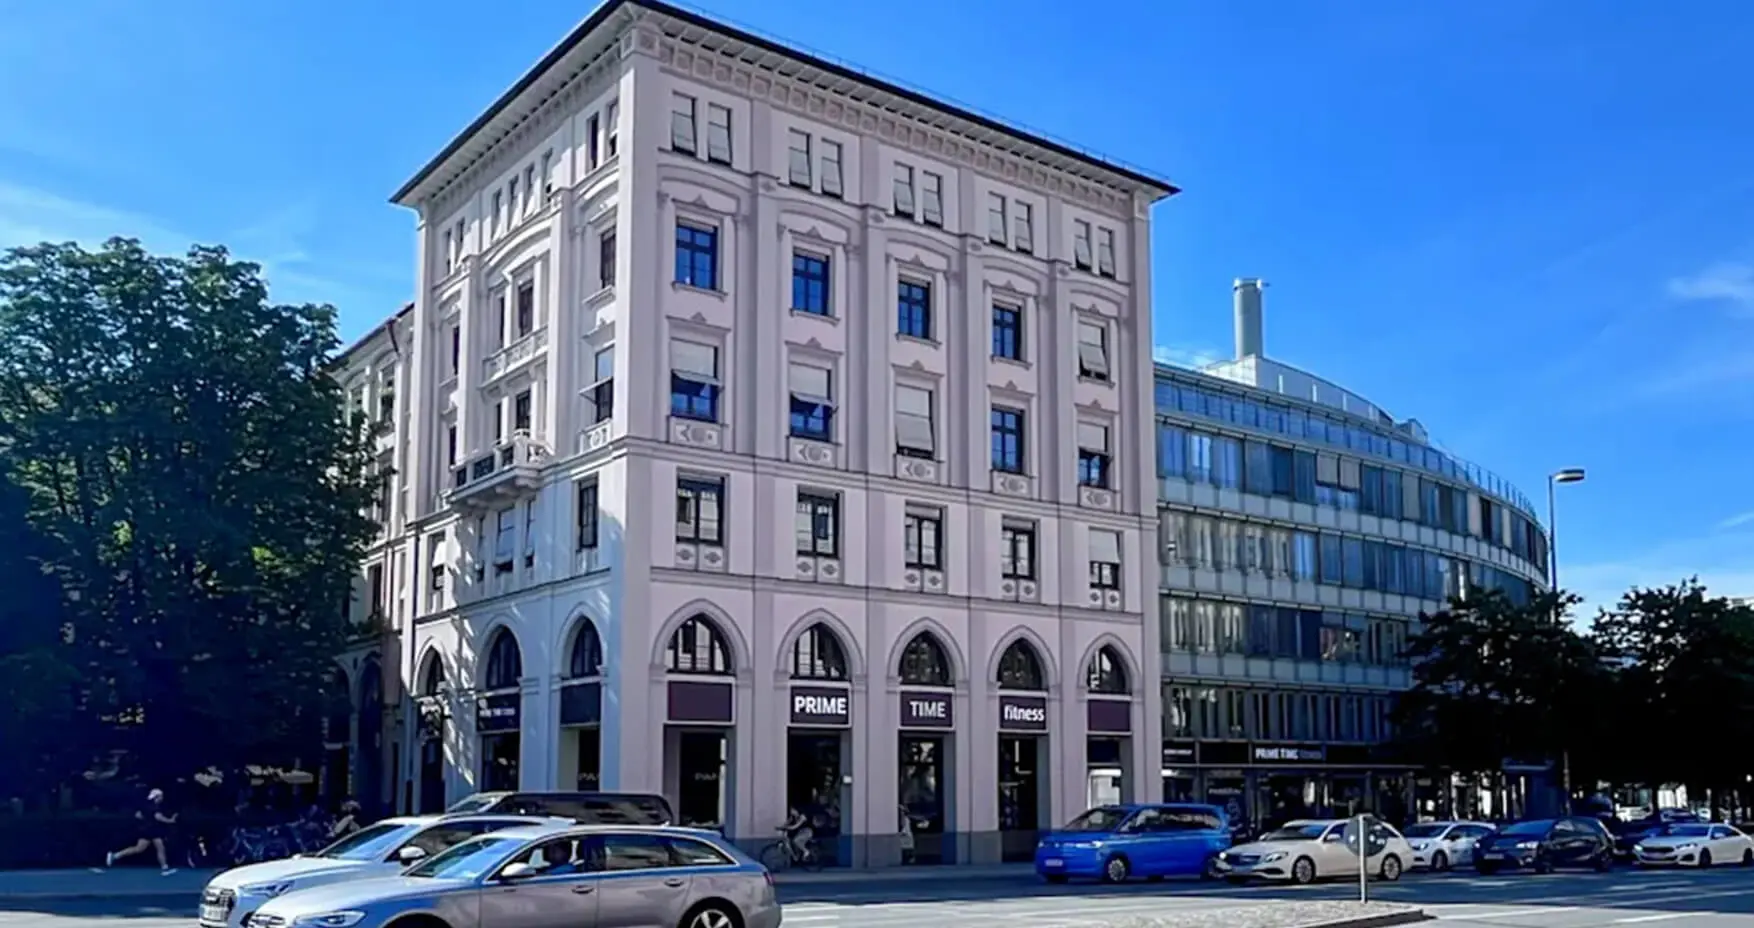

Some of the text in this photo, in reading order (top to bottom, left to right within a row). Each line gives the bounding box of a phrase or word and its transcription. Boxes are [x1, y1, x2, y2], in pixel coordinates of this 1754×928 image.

[794, 696, 847, 714] PRIME
[909, 701, 946, 717] TIME
[1004, 704, 1044, 721] fitness
